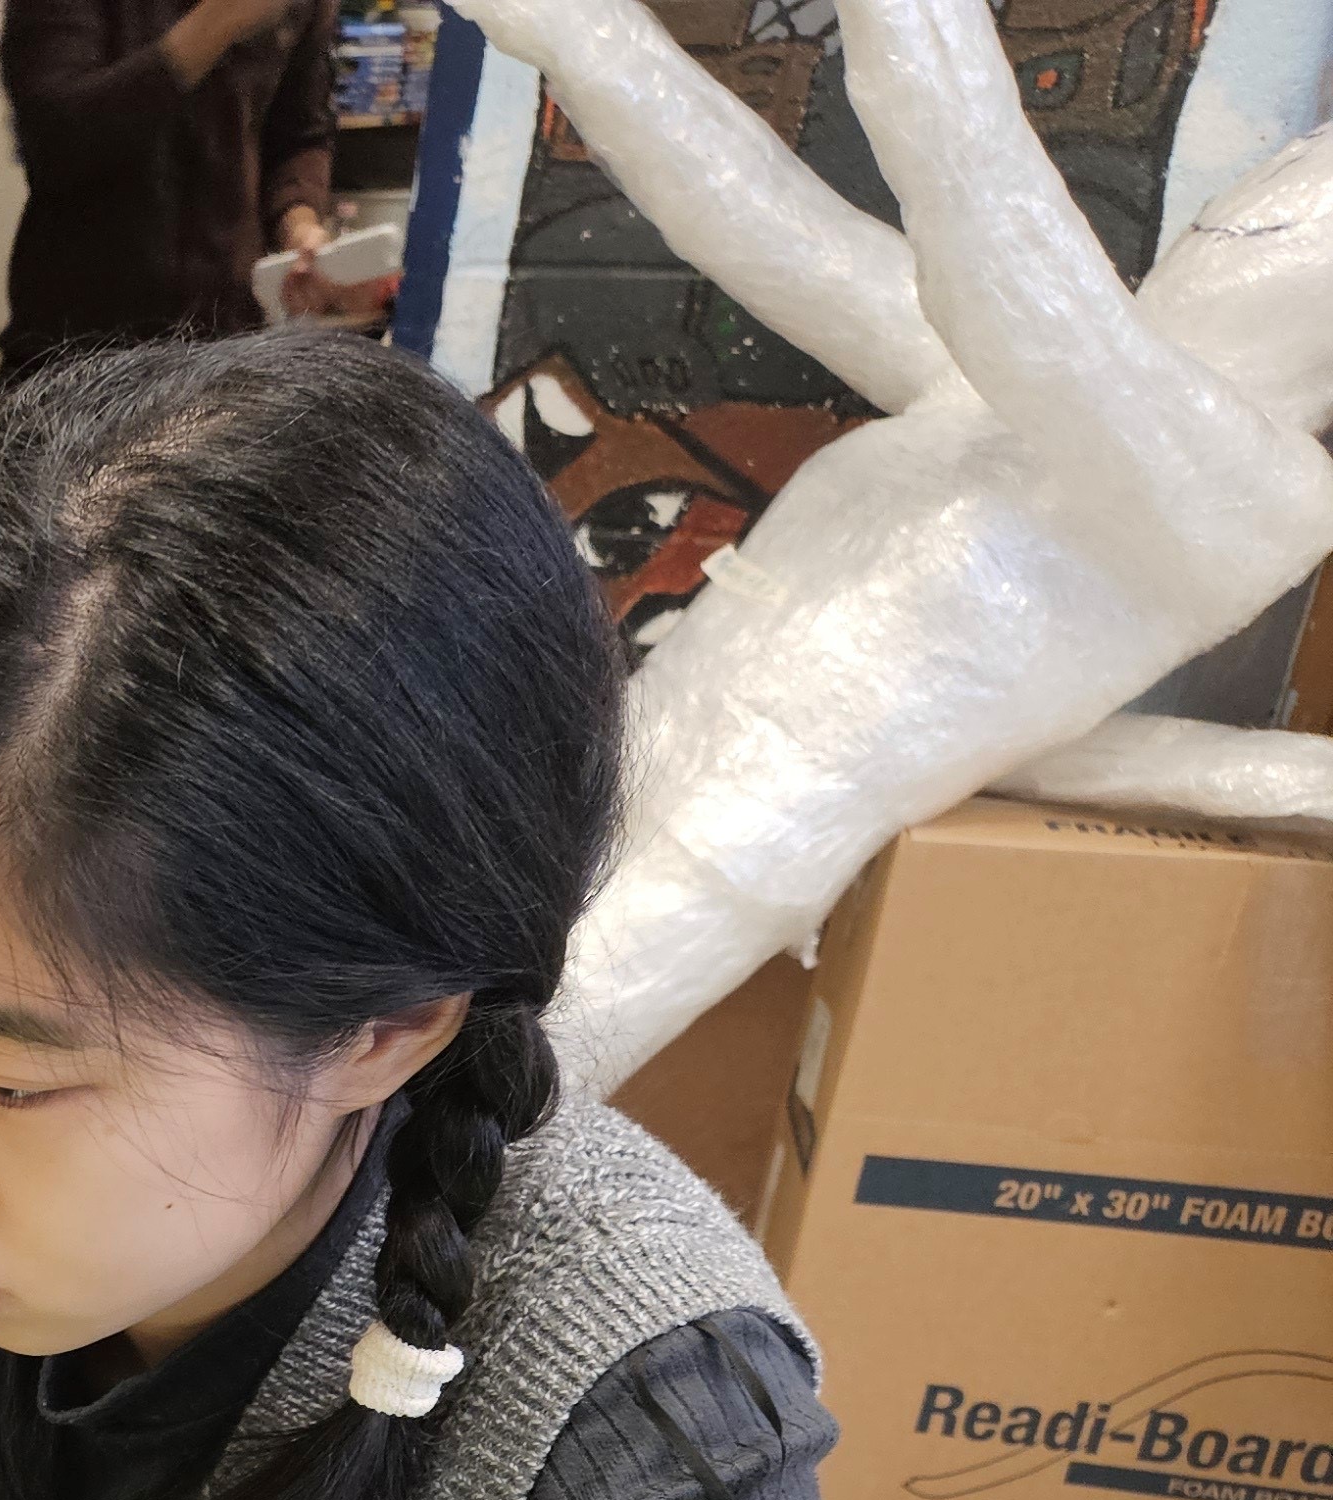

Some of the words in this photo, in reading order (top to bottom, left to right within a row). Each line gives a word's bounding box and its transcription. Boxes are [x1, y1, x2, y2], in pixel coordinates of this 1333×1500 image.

[994, 1178, 1062, 1212] 20"
[1070, 1191, 1094, 1217] x
[1102, 1188, 1171, 1222] 30"
[1180, 1196, 1288, 1236] FOAM
